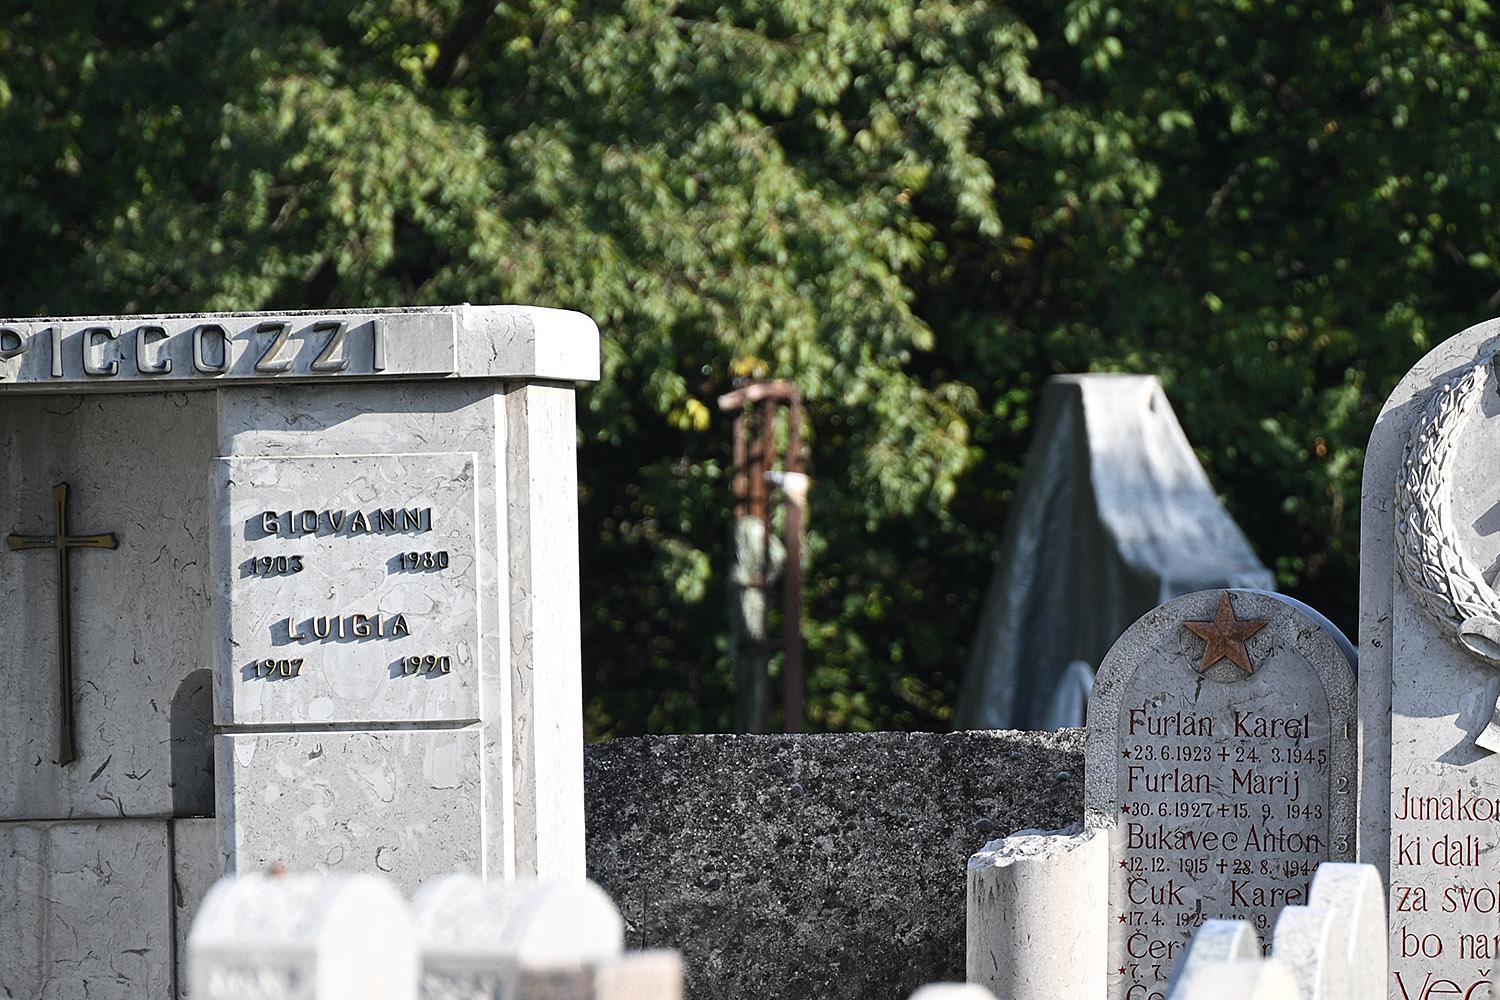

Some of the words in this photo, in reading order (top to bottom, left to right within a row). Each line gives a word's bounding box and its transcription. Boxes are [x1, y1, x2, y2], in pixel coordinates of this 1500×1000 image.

[262, 507, 433, 534] GIOVANNI
[251, 554, 304, 573] 1903
[400, 550, 449, 570] 1980
[287, 612, 412, 639] LUIGIA
[253, 657, 305, 677] 1907
[401, 655, 451, 674] 1990
[1128, 708, 1214, 737] Furlan
[1233, 711, 1310, 739] Karel
[1127, 765, 1211, 793] Furlan
[1231, 768, 1300, 801] Marij
[1286, 804, 1323, 820] 1943
[1127, 822, 1239, 852] Bukavec
[1243, 825, 1320, 854] Anton
[1397, 833, 1422, 866] ki
[1431, 833, 1480, 867] dali
[1127, 872, 1187, 906] Čuk
[1229, 879, 1310, 908] Karel
[1396, 886, 1427, 913] za
[1400, 925, 1443, 959] bo
